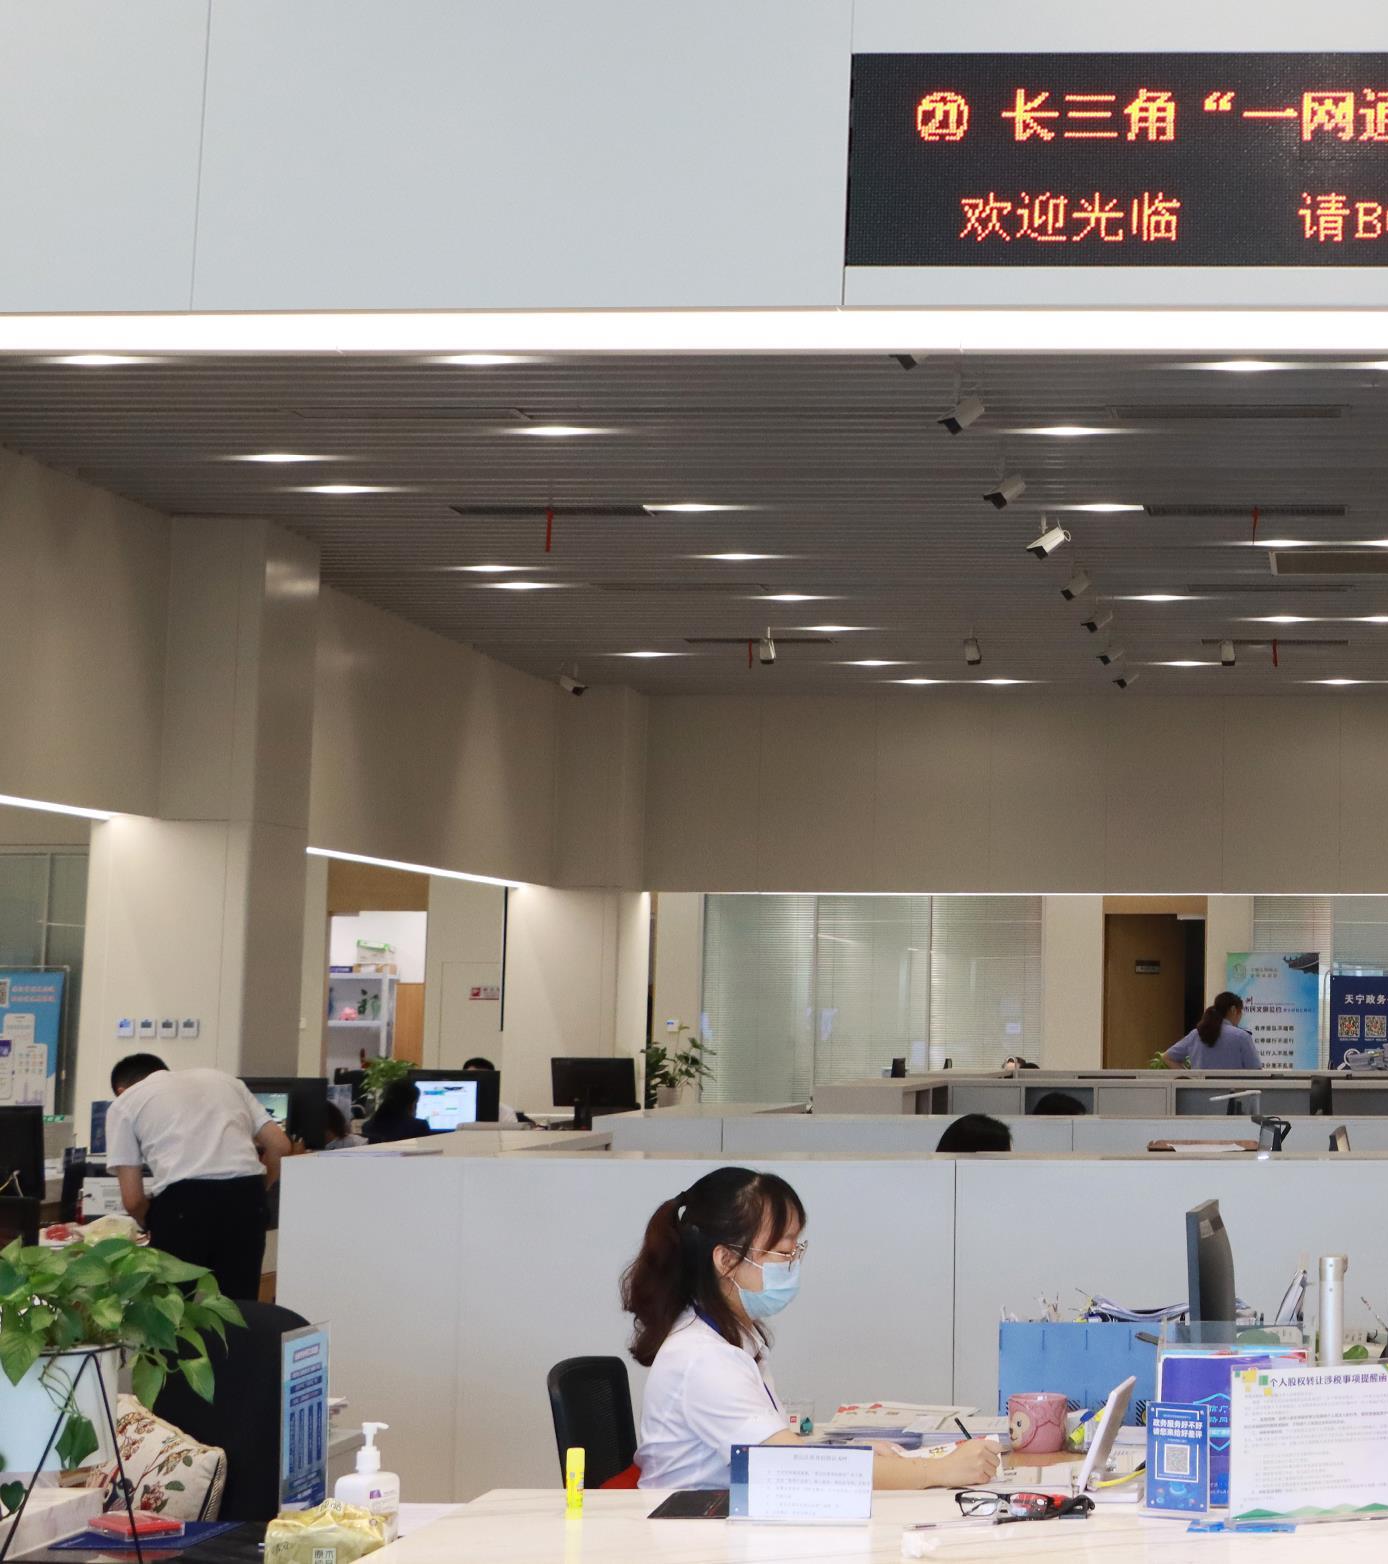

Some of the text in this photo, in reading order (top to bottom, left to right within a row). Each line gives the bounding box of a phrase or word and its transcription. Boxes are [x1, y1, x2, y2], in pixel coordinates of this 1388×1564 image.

[959, 191, 1182, 242] 欢迎光临
[1270, 1373, 1388, 1388] 个人股权转让涉税事项提醒函
